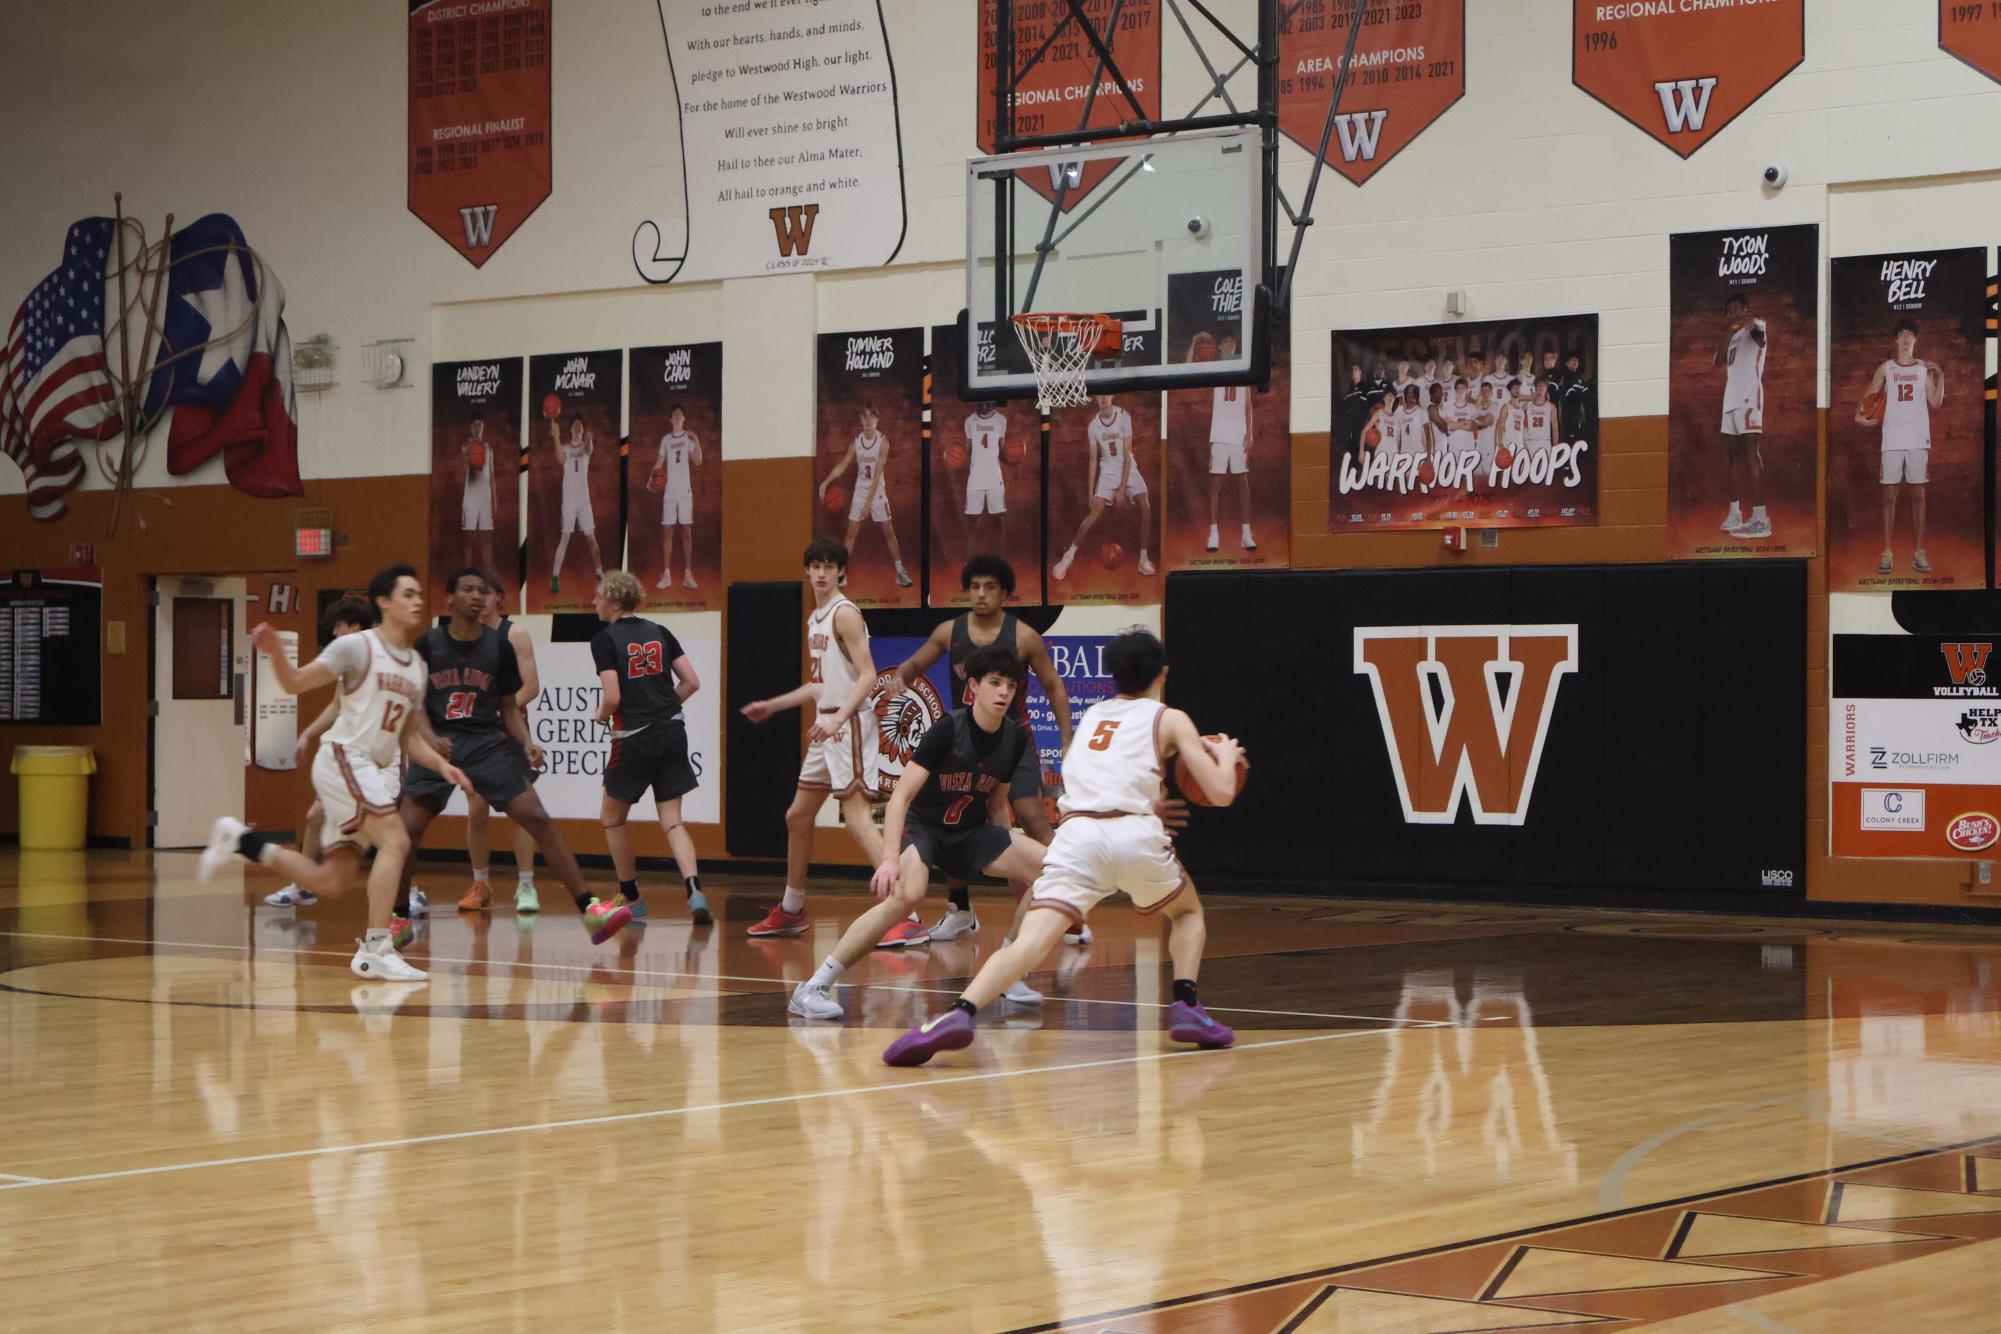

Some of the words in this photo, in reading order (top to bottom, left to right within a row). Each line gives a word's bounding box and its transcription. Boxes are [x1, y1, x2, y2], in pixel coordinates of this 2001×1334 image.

[427, 5, 467, 22] DISTRICT
[702, 7, 711, 17] to
[714, 3, 730, 15] the
[732, 0, 750, 13] end
[1018, 3, 1046, 21] 2008
[1299, 16, 1325, 33] 2003
[1363, 8, 1390, 25] 2021
[1395, 4, 1423, 21] 2023
[1596, 1, 1676, 21] REGIONAL
[1951, 3, 1983, 23] 1997
[1121, 10, 1151, 31] 2017
[687, 39, 711, 51] With
[713, 38, 730, 49] our
[806, 24, 826, 37] and
[1018, 25, 1045, 44] 2014
[1584, 31, 1618, 52] 1996
[1052, 43, 1080, 61] 2021
[1296, 57, 1333, 74] AREA
[1337, 46, 1425, 69] CHAMPIONS
[691, 69, 723, 85] pledge
[725, 68, 736, 78] to
[739, 59, 790, 76] Westwood
[823, 55, 842, 66] our
[1299, 76, 1325, 92] 1994
[1331, 72, 1356, 88] 197
[1363, 68, 1389, 85] 2010
[1395, 64, 1422, 82] 2014
[1428, 60, 1455, 79] 2021
[684, 102, 700, 114] For
[703, 99, 718, 111] the
[721, 96, 748, 110] home
[751, 94, 761, 106] of
[763, 92, 780, 105] the
[783, 85, 836, 102] Westwood
[840, 82, 887, 96] Warriors
[1654, 76, 1718, 134] W
[433, 125, 482, 141] REGIONAL
[485, 118, 525, 134] FINALIST
[724, 128, 745, 140] Will
[747, 126, 769, 138] ever
[772, 122, 799, 136] shine
[802, 120, 813, 132] so
[816, 116, 848, 133] bright
[1018, 114, 1045, 133] 2021
[1332, 109, 1388, 162] W
[717, 159, 739, 172] Hail
[741, 157, 751, 169] to
[753, 154, 775, 168] thee
[778, 153, 795, 165] our
[798, 148, 826, 163] Alma
[717, 188, 733, 202] All
[734, 187, 754, 201] hail
[756, 186, 766, 198] to
[768, 183, 804, 198] orange
[806, 180, 826, 193] and
[459, 205, 498, 248] W
[769, 203, 820, 257] W
[1721, 234, 1768, 257] TYSON
[1718, 253, 1770, 277] WOODS
[1881, 259, 1938, 281] HENRY
[1214, 276, 1243, 295] COLE
[1888, 280, 1926, 304] BELL
[846, 335, 893, 355] SUMNER
[563, 357, 588, 374] JOHN
[665, 350, 691, 366] JOHN
[845, 351, 895, 371] HOLLAND
[456, 364, 500, 381] LANDEYN
[554, 373, 596, 391] MCNAIR
[664, 366, 691, 383] CHUO
[456, 379, 500, 397] VALLERY
[1897, 384, 1914, 402] 12
[981, 433, 989, 449] 4
[1489, 440, 1588, 488] HOOPS
[627, 640, 663, 679] 23
[1941, 643, 1993, 685] W
[1933, 686, 1999, 697] VOLLEYBALL
[445, 692, 477, 720] 21
[918, 682, 942, 724] SCHOO
[380, 700, 405, 733] 12
[1353, 623, 1579, 826] W
[1980, 717, 1998, 727] TX
[1088, 720, 1120, 752] 5
[1845, 704, 1856, 777] WARRIORS
[939, 771, 973, 792] VISTA
[1884, 792, 1903, 813] C
[1866, 817, 1896, 825] COLONY
[1898, 817, 1920, 825] CREEK
[1761, 869, 1793, 880] LISCO
